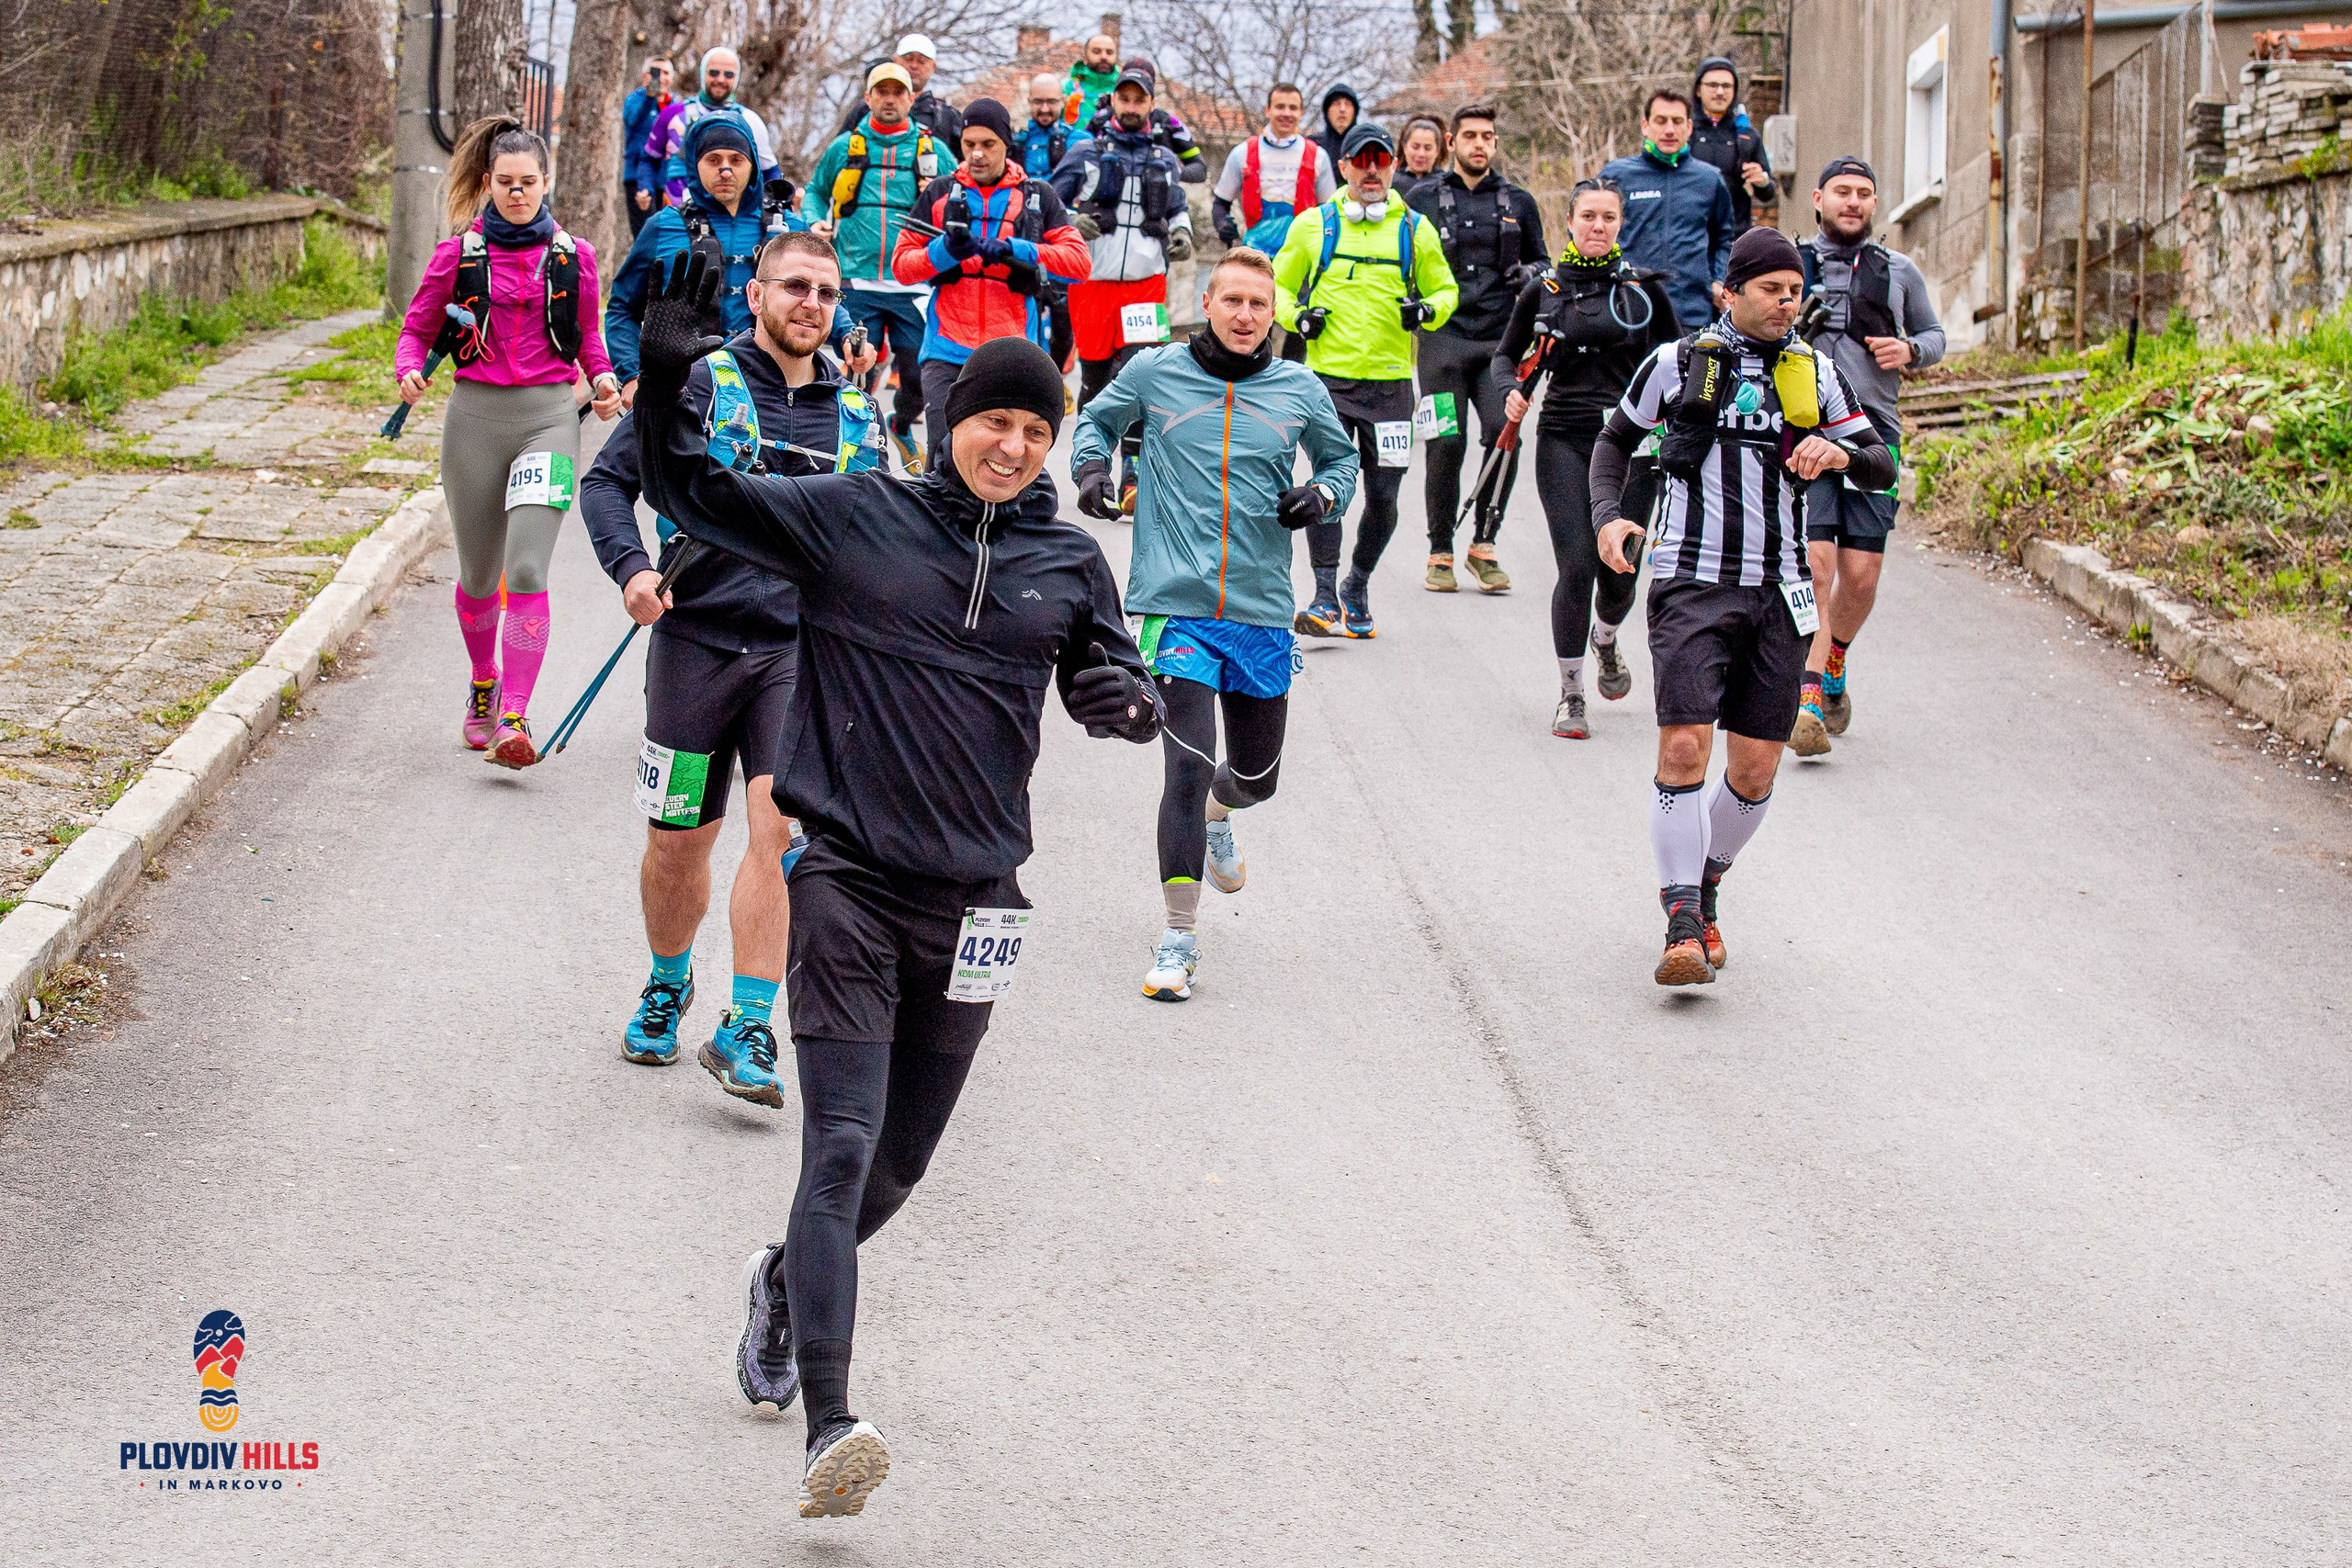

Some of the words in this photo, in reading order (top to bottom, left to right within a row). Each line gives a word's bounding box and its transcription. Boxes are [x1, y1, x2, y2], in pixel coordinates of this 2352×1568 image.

[1126, 315, 1152, 327] 4154
[1717, 402, 1783, 434] fbe
[1382, 435, 1408, 450] 4113
[510, 468, 543, 489] 4195
[1791, 587, 1815, 610] 414
[1175, 646, 1194, 654] HILLS
[1001, 914, 1017, 925] 44K
[959, 936, 1023, 966] 4249
